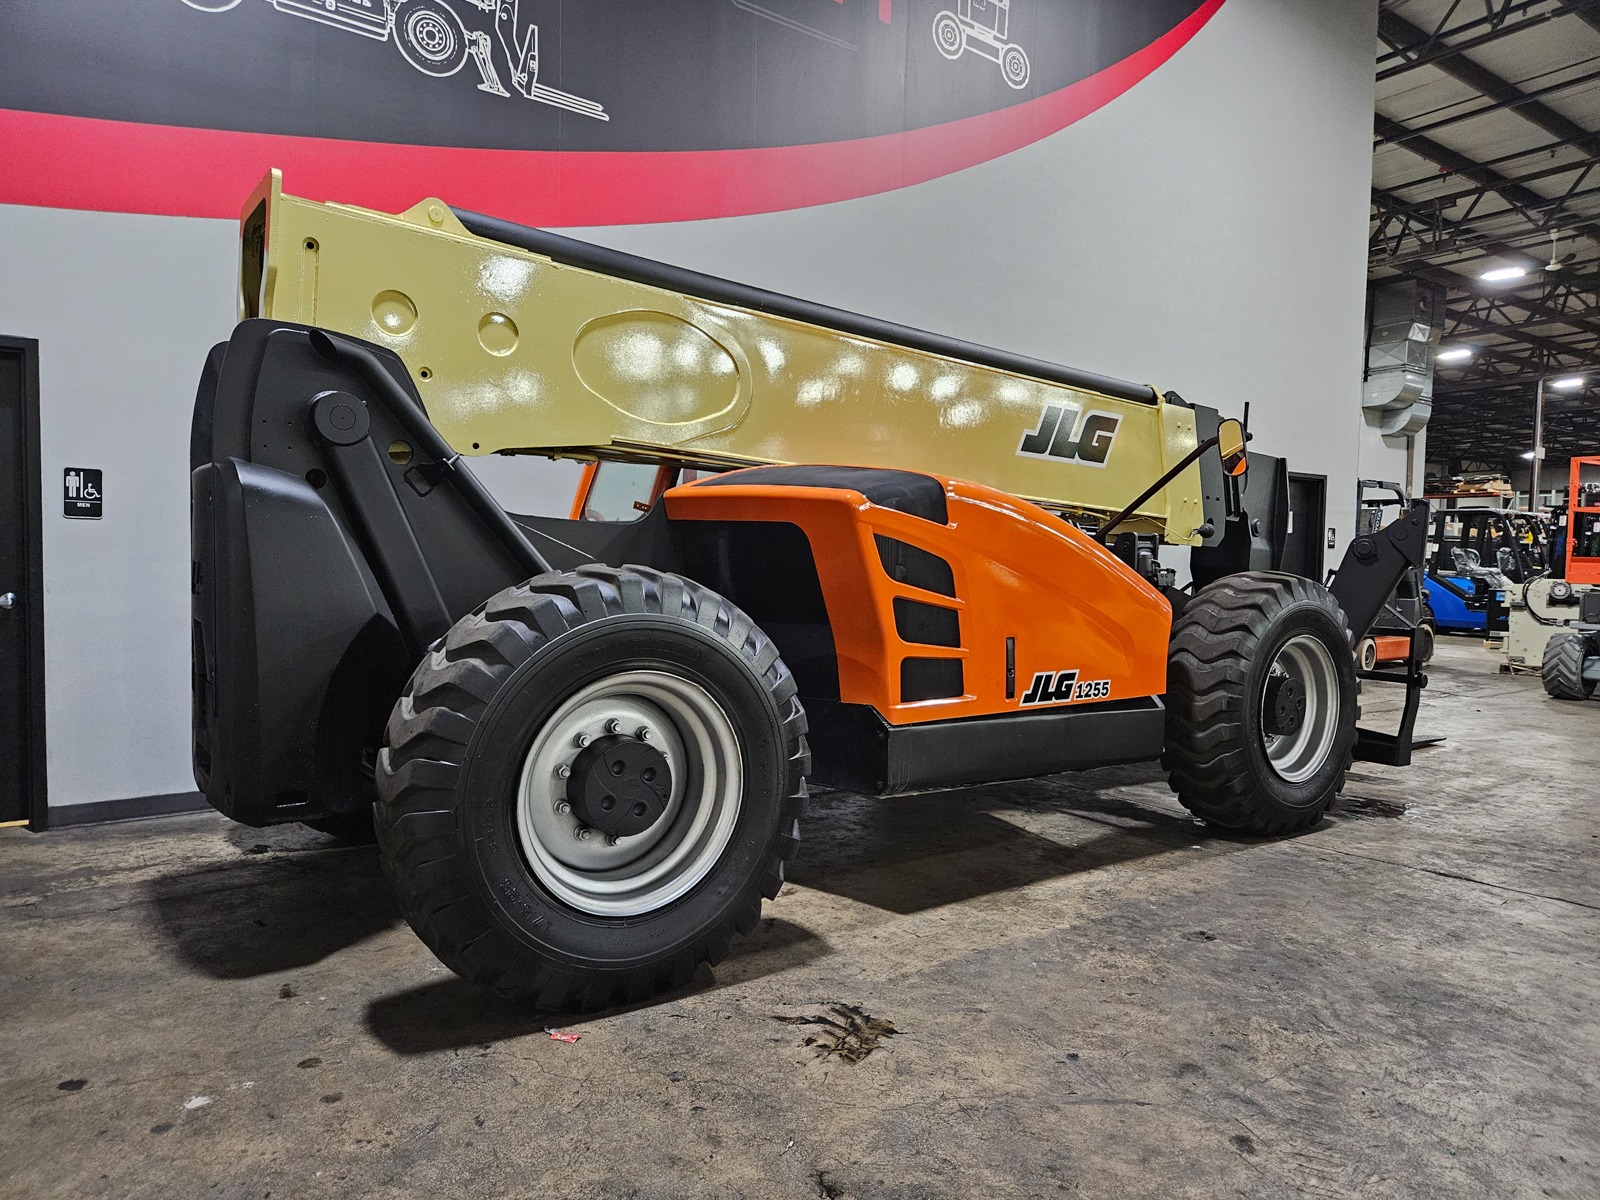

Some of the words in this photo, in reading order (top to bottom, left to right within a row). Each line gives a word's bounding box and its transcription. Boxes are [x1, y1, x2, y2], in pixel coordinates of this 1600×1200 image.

[1019, 404, 1120, 464] JLG
[1373, 511, 1382, 534] YOTA
[1021, 671, 1078, 704] JLG
[1074, 681, 1110, 699] 1255
